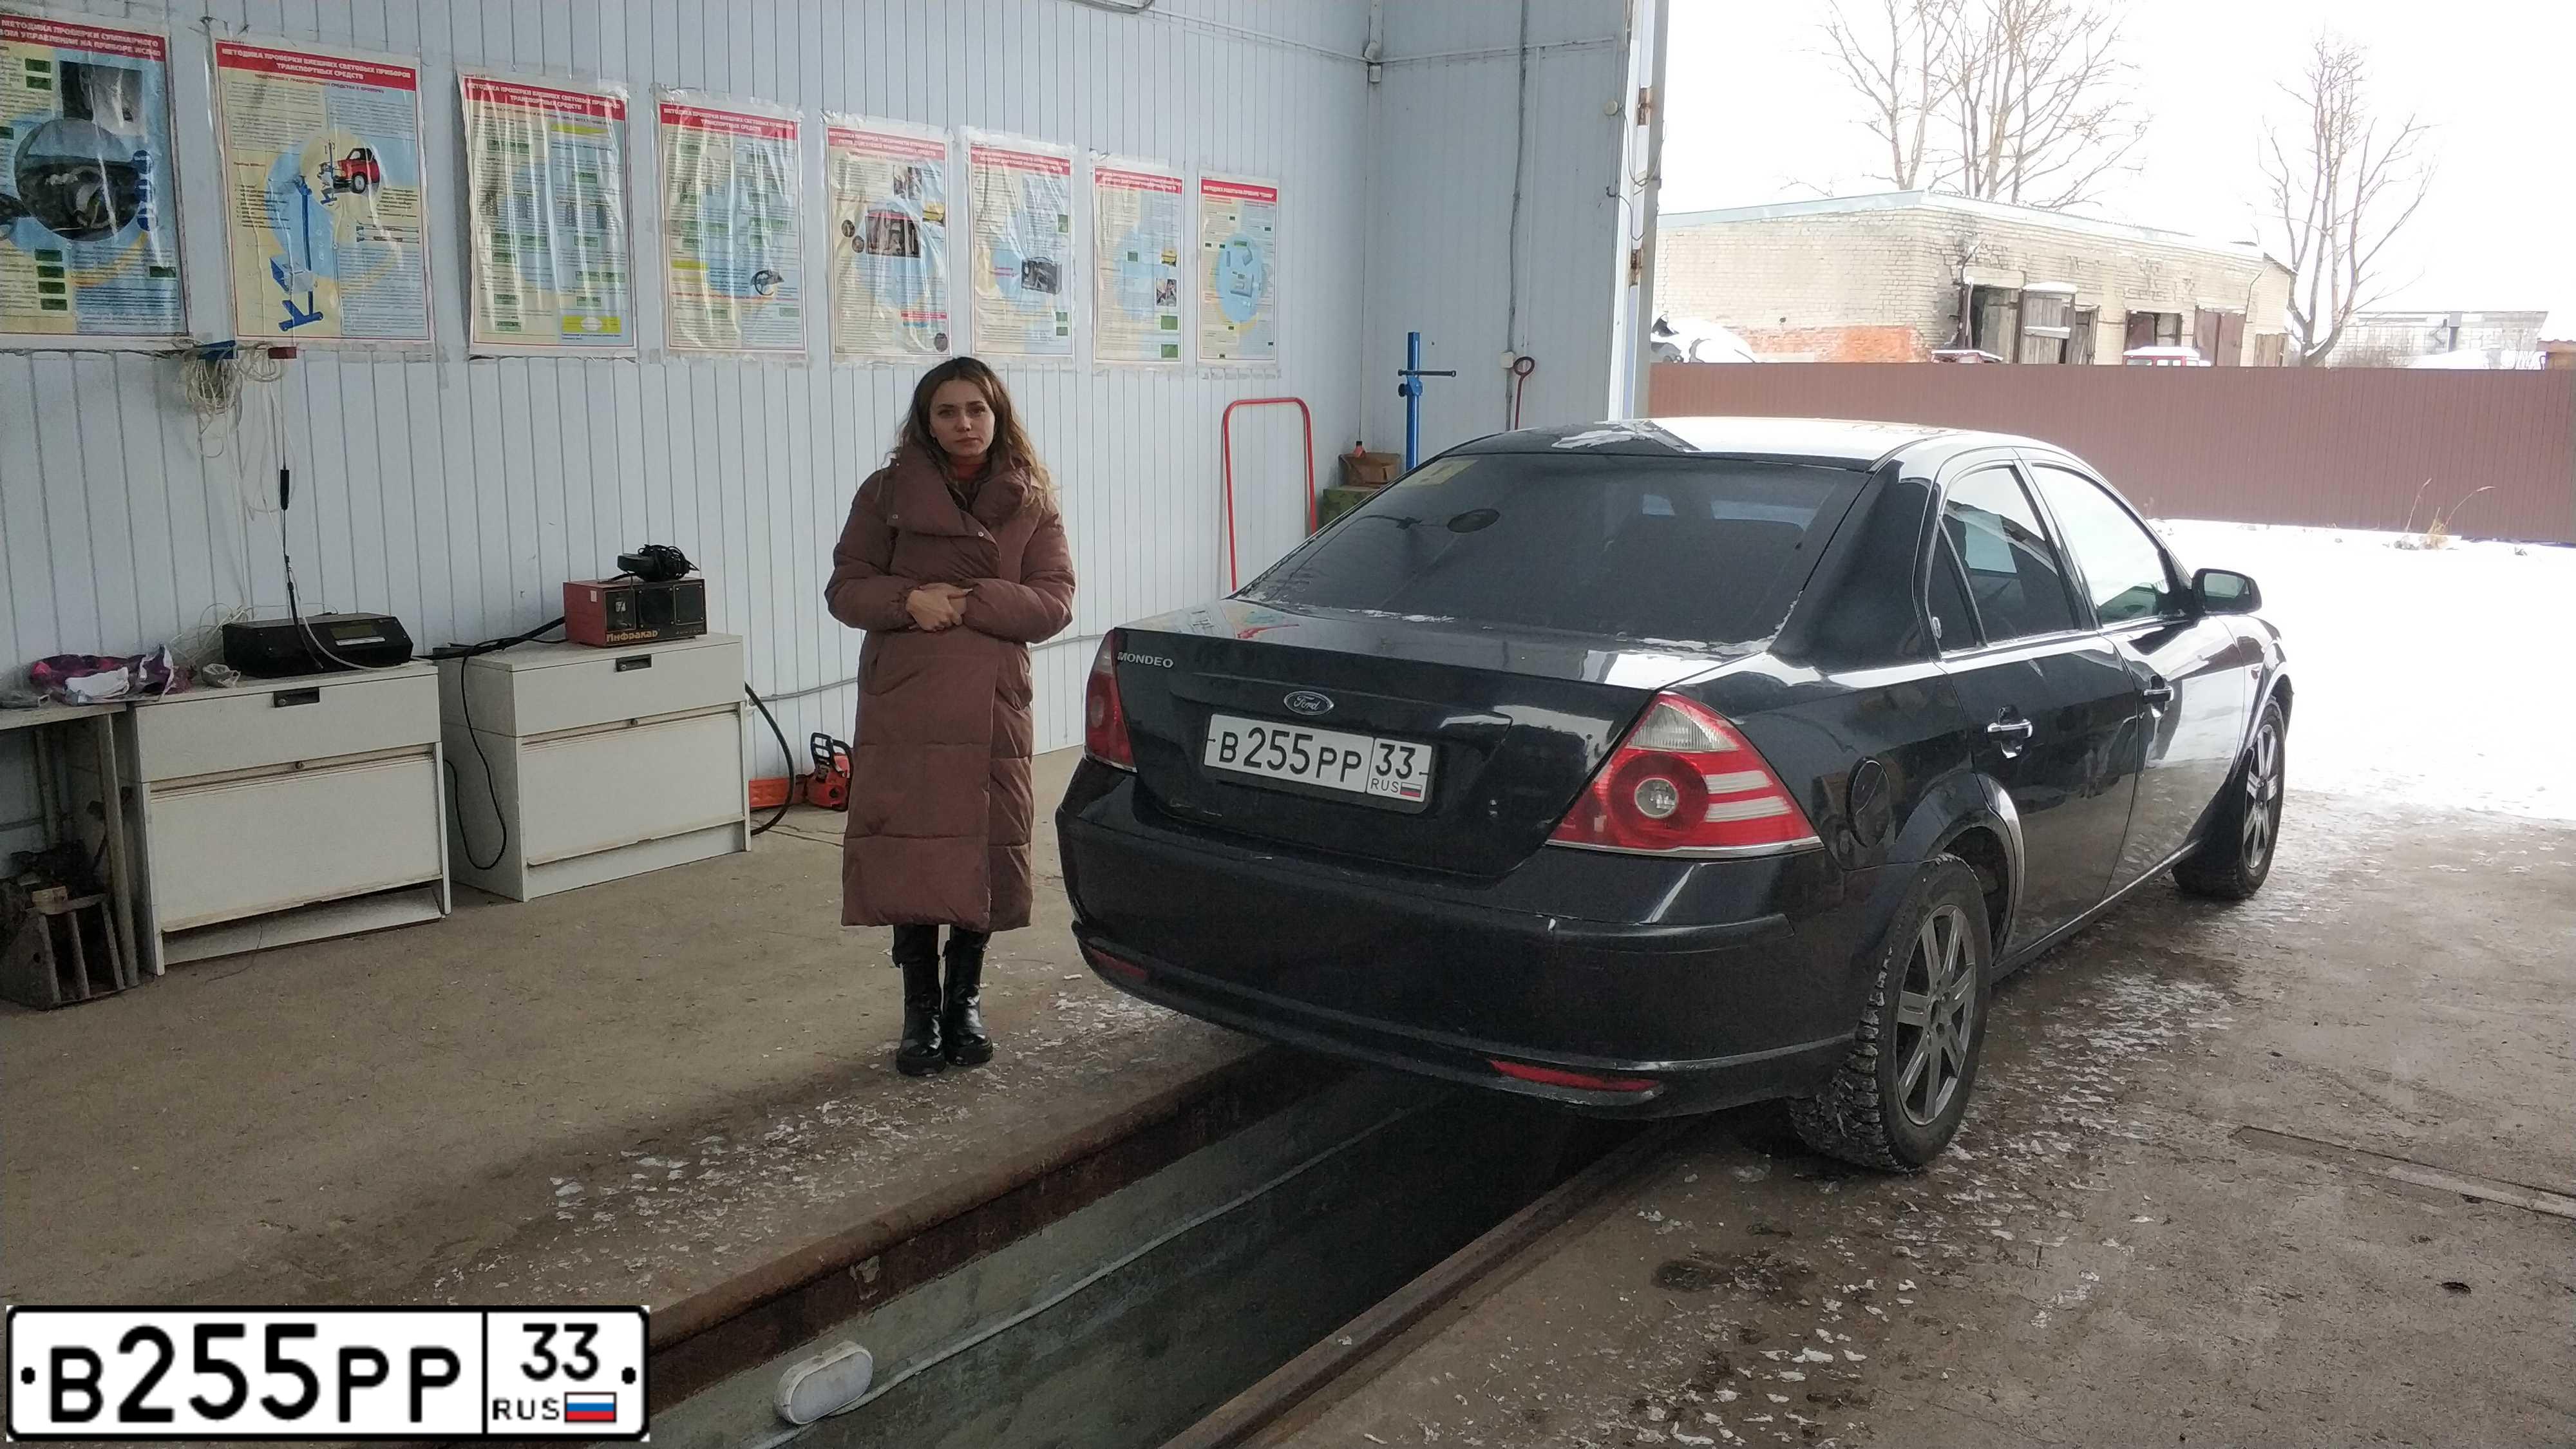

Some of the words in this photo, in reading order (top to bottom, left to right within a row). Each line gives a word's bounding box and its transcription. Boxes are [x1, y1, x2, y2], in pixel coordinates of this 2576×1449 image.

[1, 19, 52, 33] МЕТОДИКА
[53, 27, 99, 39] ПРОВЕРКИ
[222, 48, 264, 59] МЕТОДИКА
[265, 53, 303, 64] ПРОВЕРКИ
[303, 58, 338, 68] ВНЕШНИХ
[338, 62, 375, 73] СВЕТОВЫХ
[375, 67, 411, 79] ПРИБОРОВ
[276, 62, 333, 76] ТРАНСПОРТНЫХ
[334, 70, 365, 80] СРЕДСТВ
[500, 86, 532, 96] ПРОВЕРКИ
[1117, 650, 1173, 669] MONDEO
[1293, 694, 1321, 712] Ford
[1218, 726, 1363, 783] В255РР
[1375, 743, 1416, 780] 33
[1370, 778, 1399, 793] RUS
